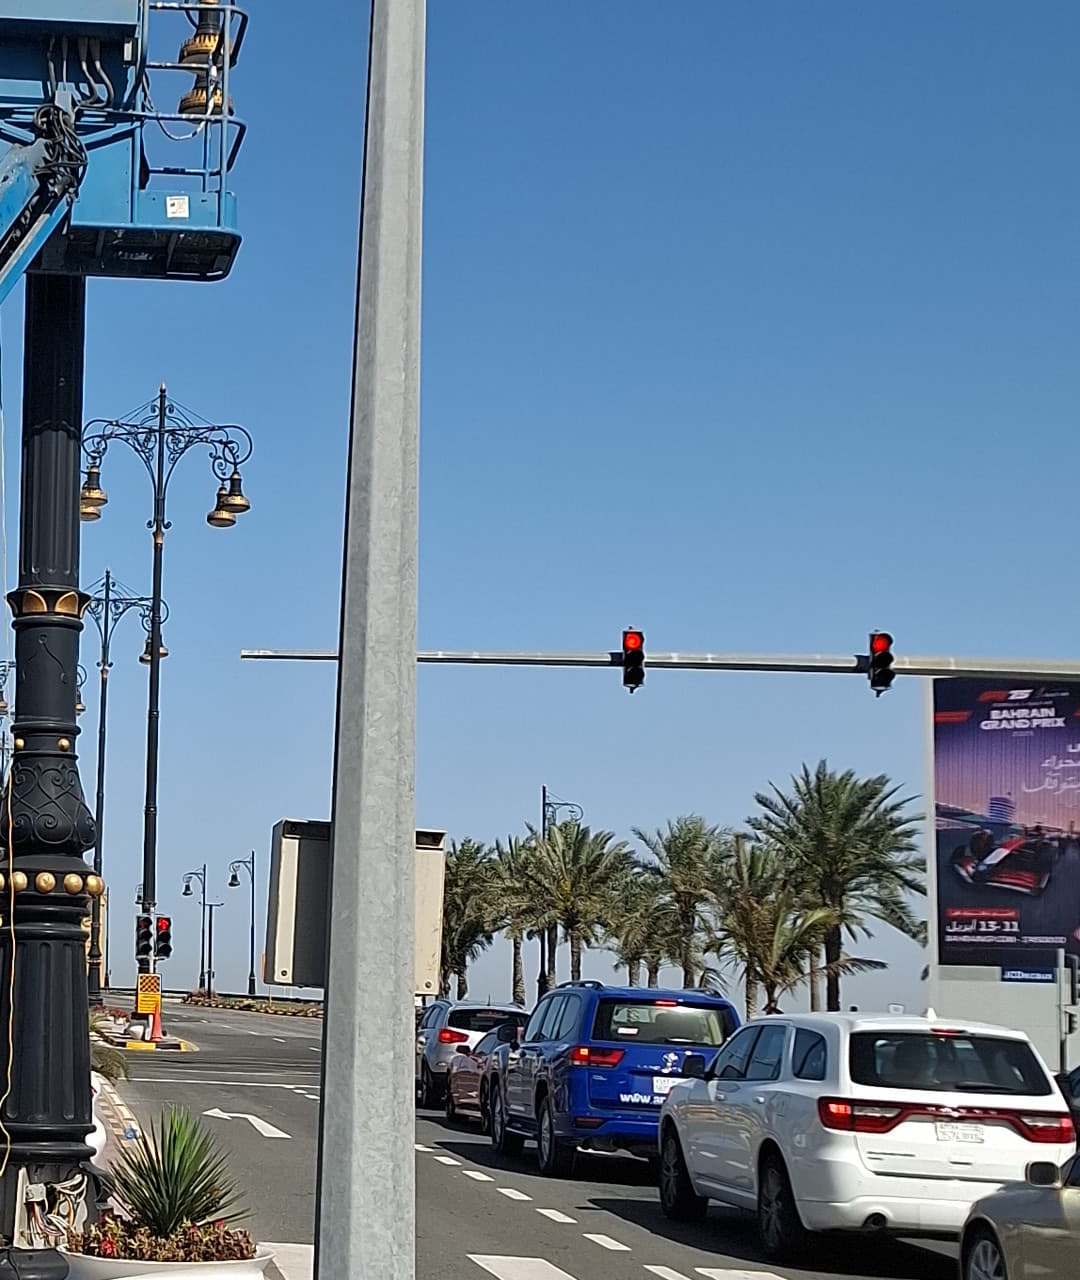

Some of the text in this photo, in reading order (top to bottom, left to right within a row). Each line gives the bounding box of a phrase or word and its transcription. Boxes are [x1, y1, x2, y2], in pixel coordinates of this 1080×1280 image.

[990, 707, 1056, 719] BAHRAIN
[980, 717, 1066, 730] GRAND PRIX
